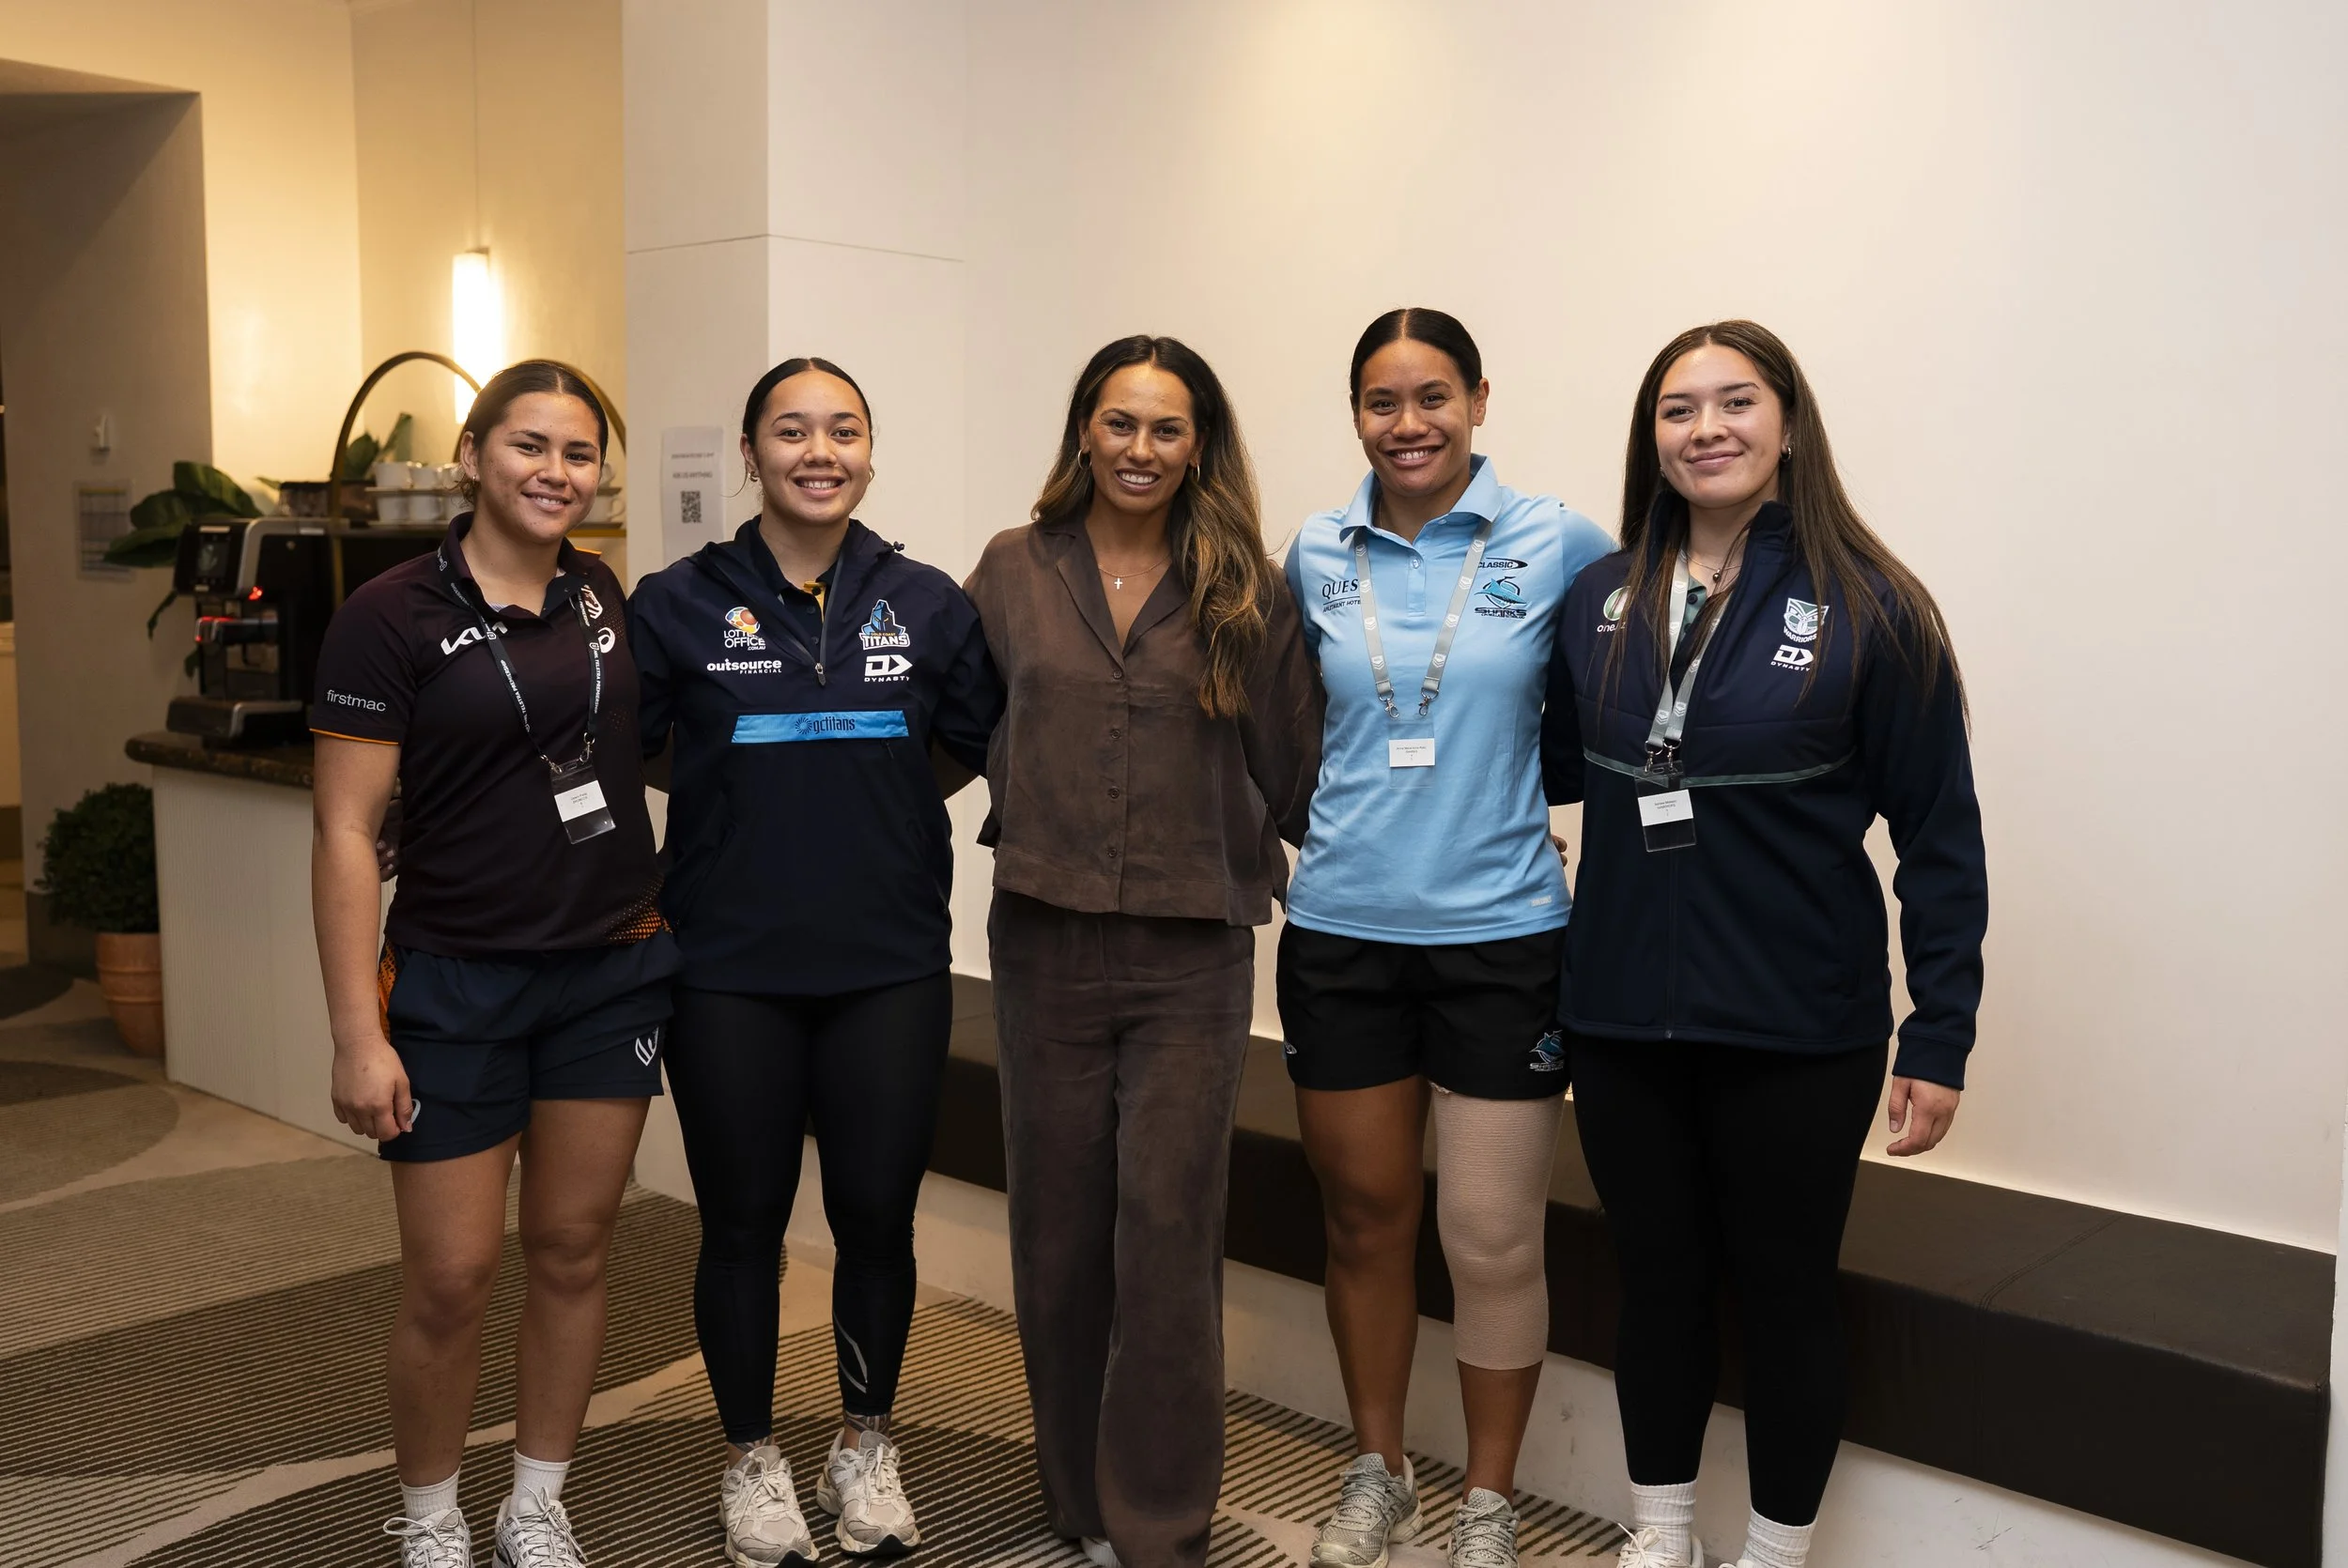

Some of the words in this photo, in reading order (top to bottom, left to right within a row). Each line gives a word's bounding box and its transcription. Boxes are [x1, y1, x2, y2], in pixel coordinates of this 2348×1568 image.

[1321, 578, 1359, 599] QUES
[1475, 607, 1528, 618] SHARKS
[862, 635, 908, 648] TITANS
[1784, 625, 1817, 643] WARRIORS
[724, 637, 766, 649] OFFICE
[706, 658, 782, 671] outsource
[1770, 661, 1811, 671] DYNASTY
[327, 689, 386, 712] firstmac
[515, 691, 527, 714] TELSTRA
[812, 716, 856, 735] gctitans
